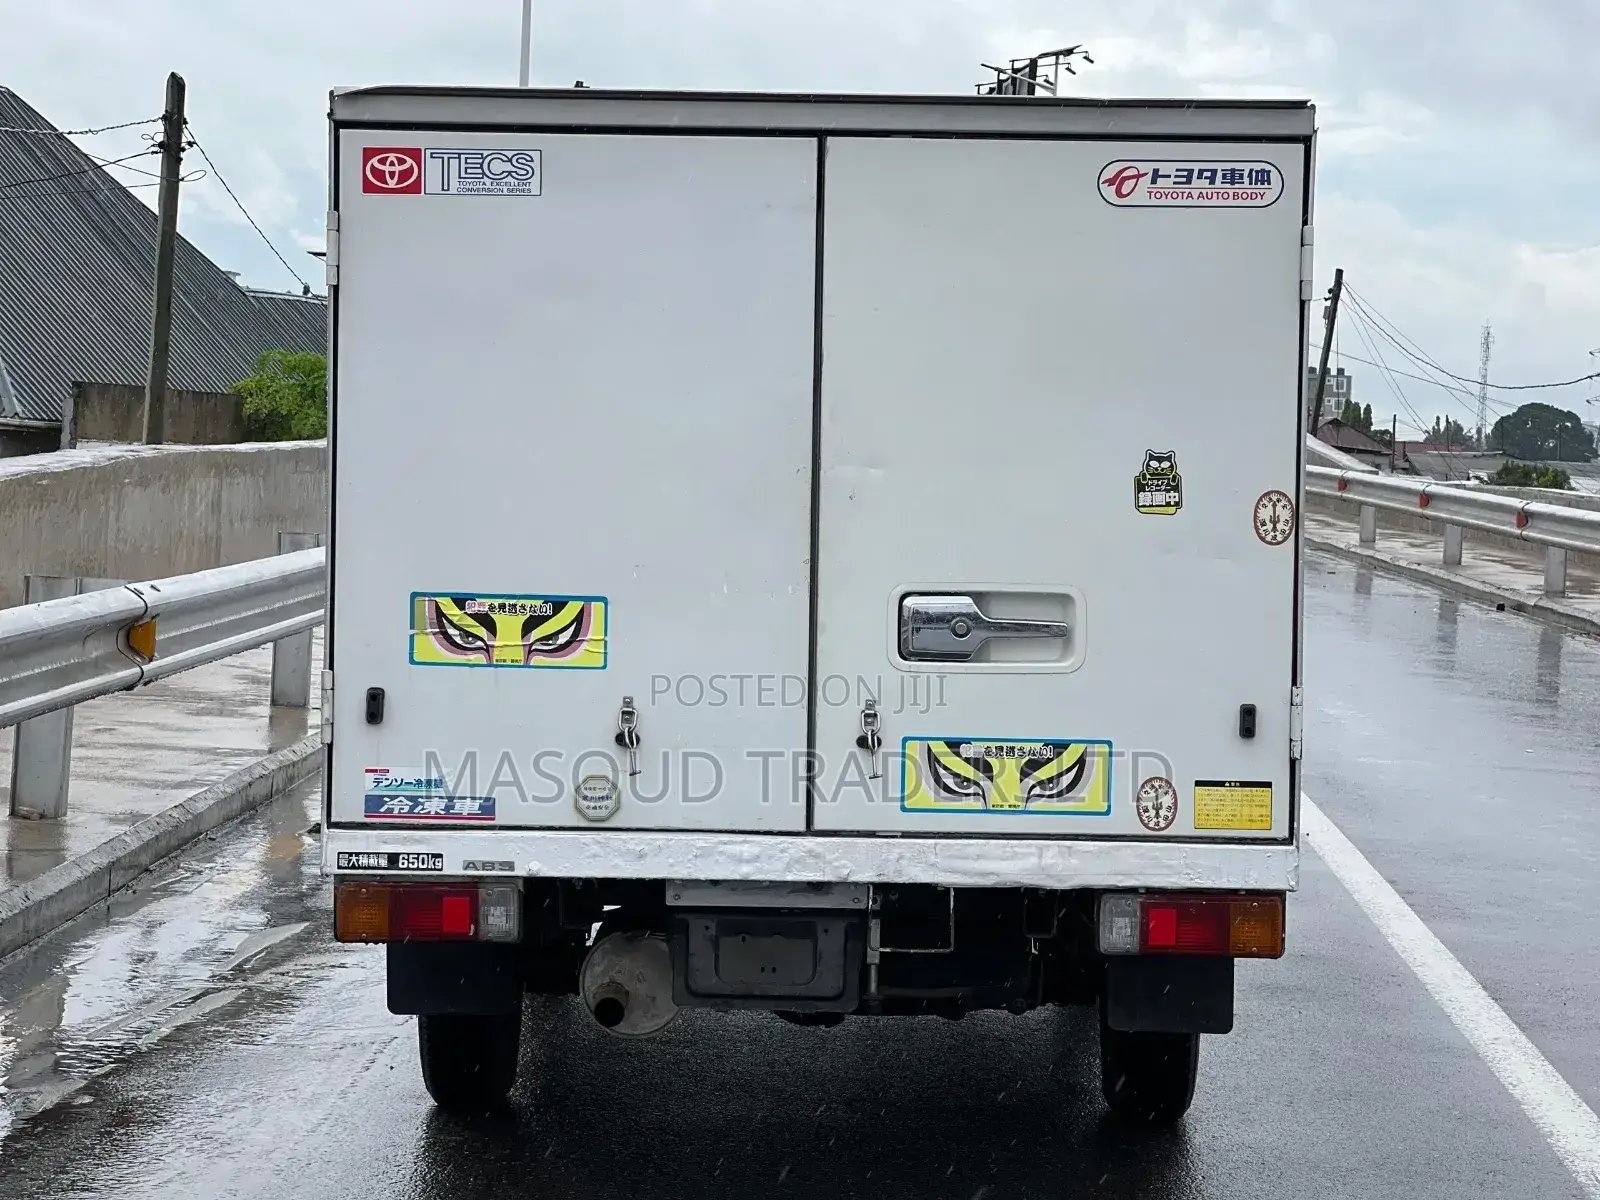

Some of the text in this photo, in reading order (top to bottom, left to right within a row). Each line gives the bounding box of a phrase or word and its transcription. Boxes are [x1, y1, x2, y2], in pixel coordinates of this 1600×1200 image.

[430, 152, 535, 191] TECS
[1150, 168, 1272, 186] トヨタ車体
[1147, 190, 1267, 201] TOYOTA AUTO BODY
[379, 796, 483, 815] 冷凍車
[338, 853, 443, 869] 最大積載量 650kg
